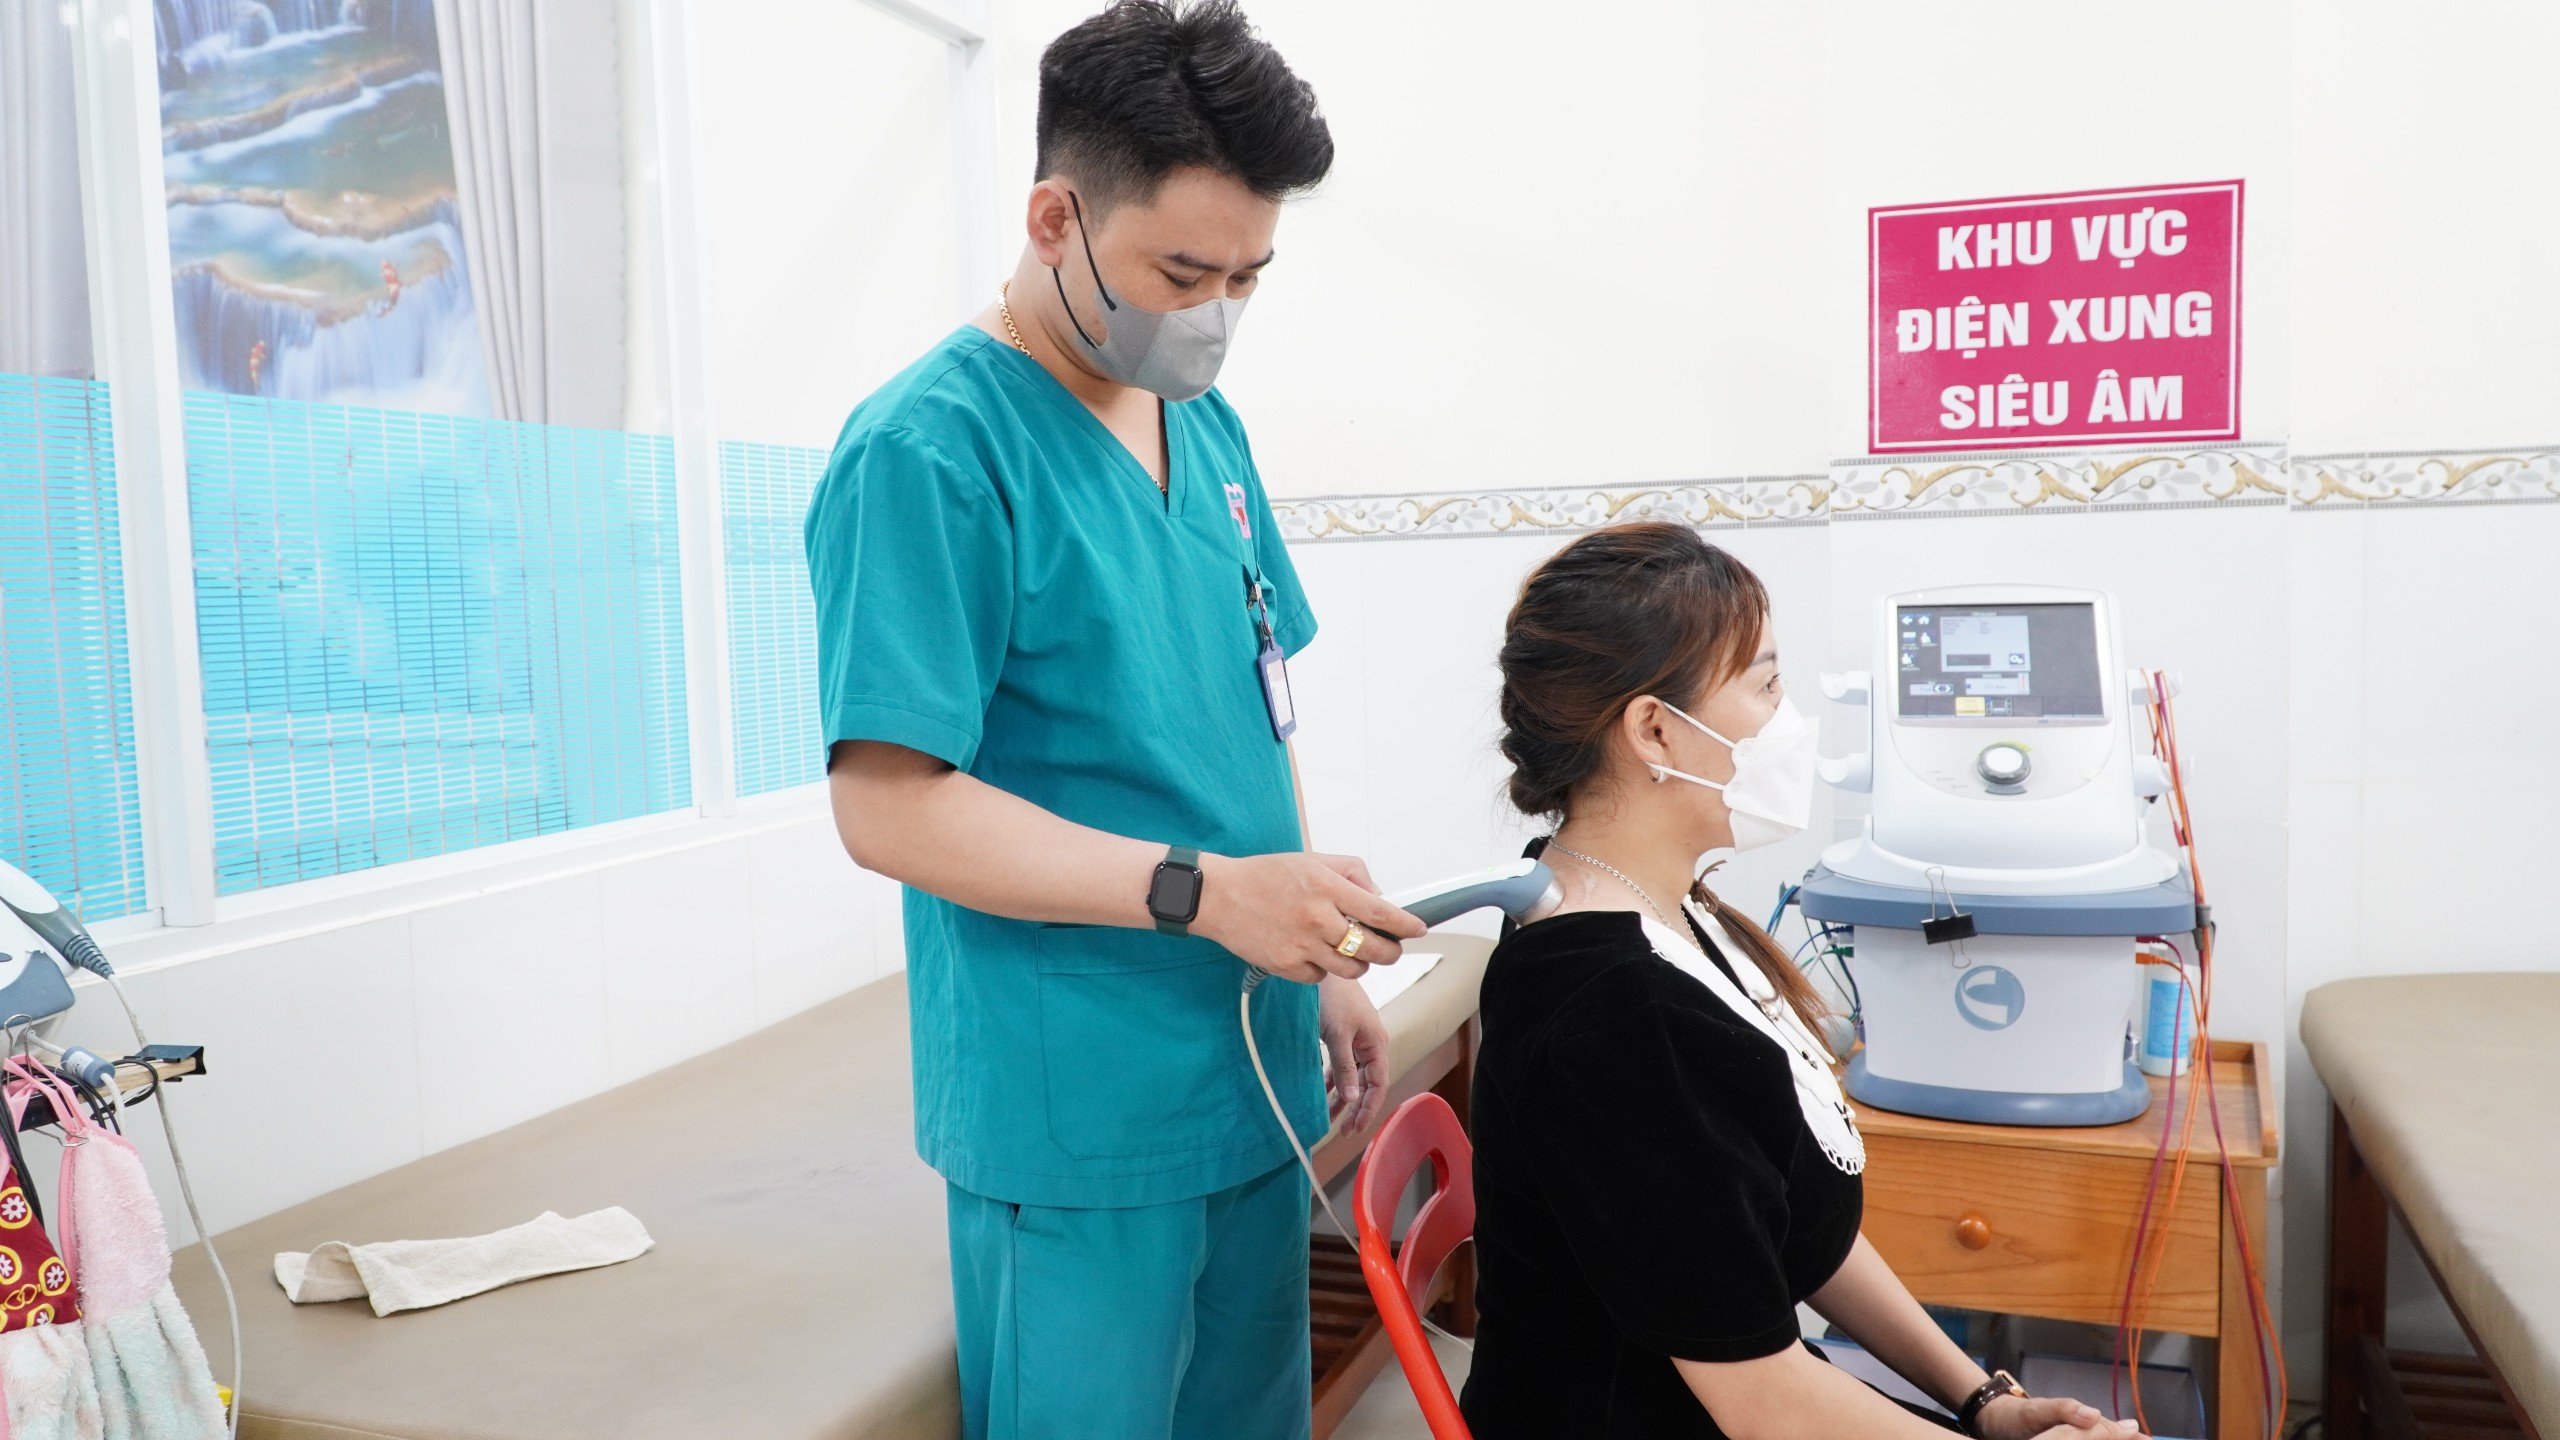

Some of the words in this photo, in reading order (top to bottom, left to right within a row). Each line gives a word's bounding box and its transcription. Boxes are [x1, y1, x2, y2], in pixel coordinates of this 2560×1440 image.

[1938, 219, 2052, 271] KHU
[2071, 206, 2188, 269] VỰC
[1896, 296, 2029, 359] ĐIỆN
[2048, 290, 2213, 345] XUNG
[1940, 373, 2069, 430] SIÊU
[2087, 368, 2183, 424] ÂM
